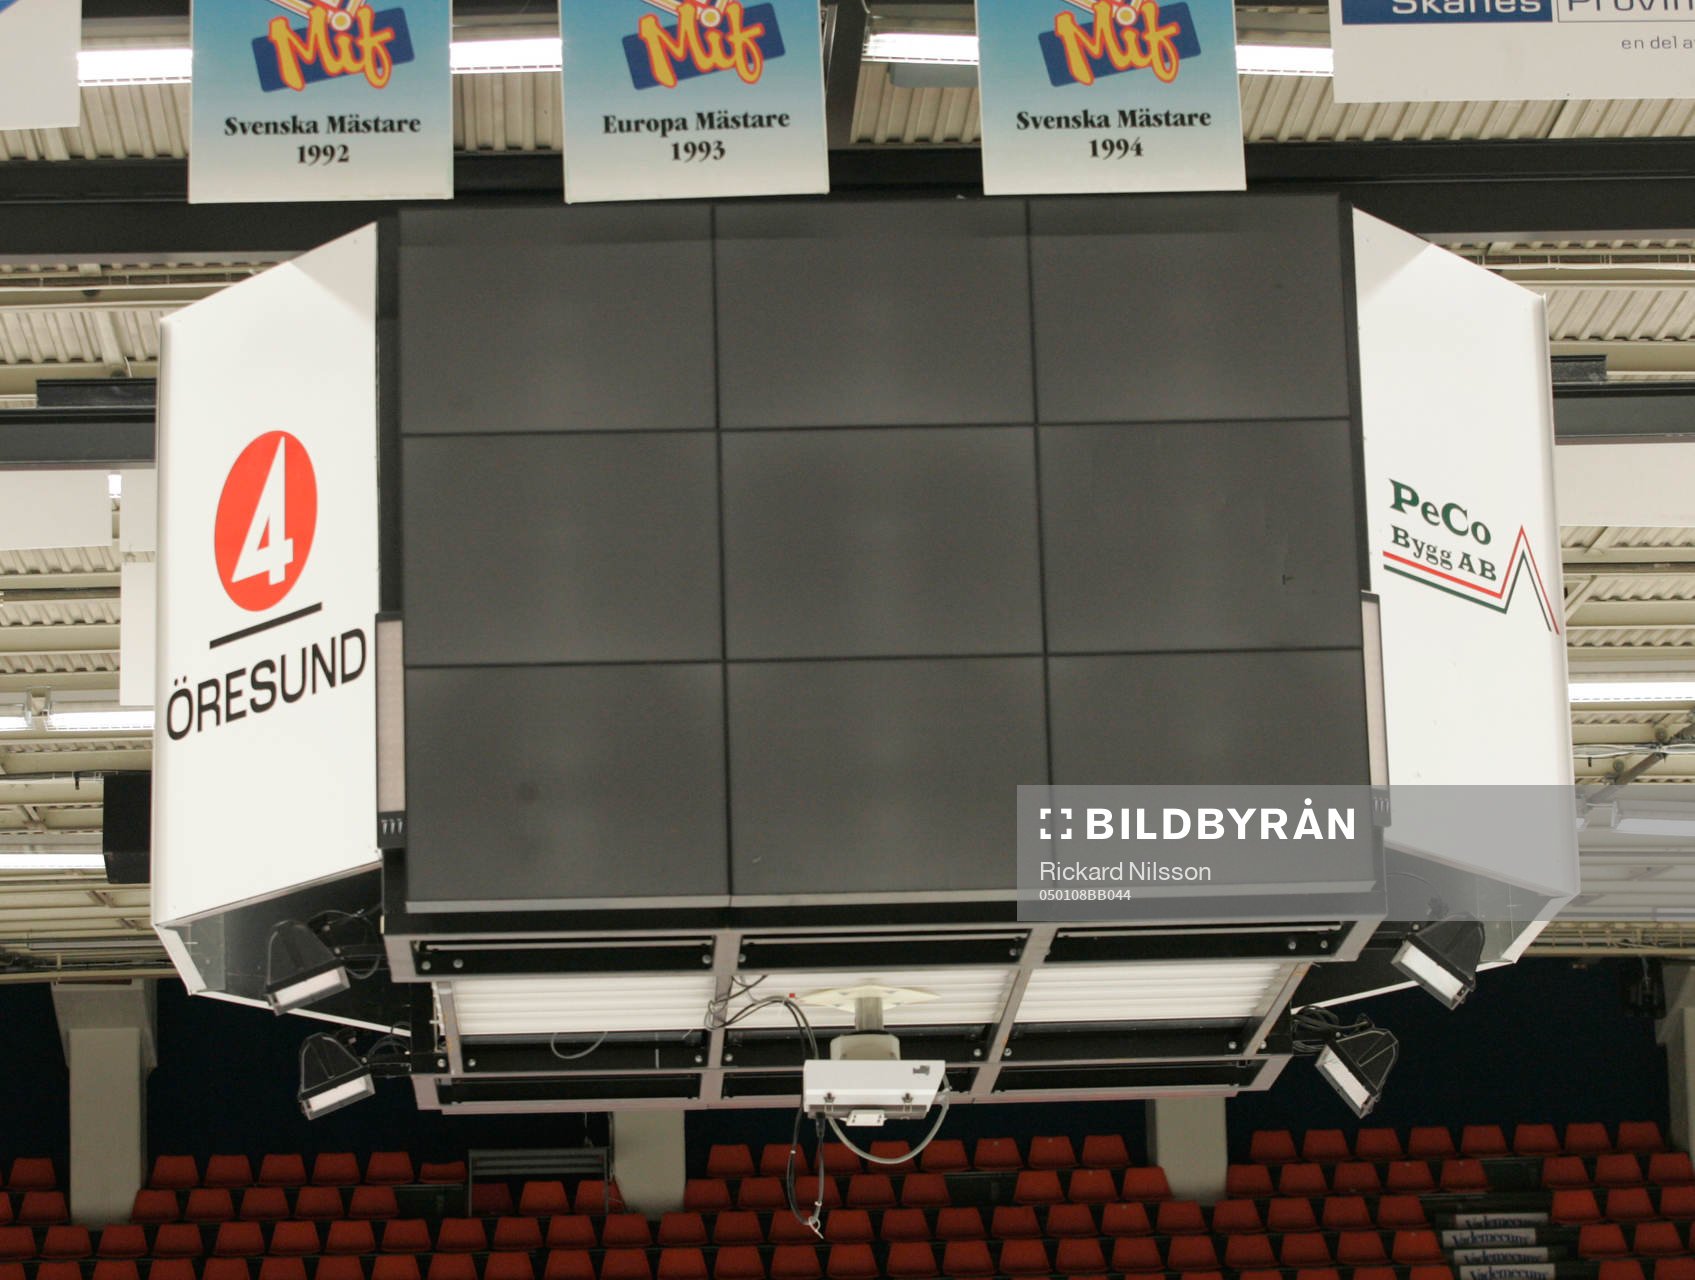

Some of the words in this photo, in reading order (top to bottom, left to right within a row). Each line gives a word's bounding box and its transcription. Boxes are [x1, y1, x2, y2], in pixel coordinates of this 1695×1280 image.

[1621, 39, 1644, 49] en
[1650, 35, 1677, 49] del
[1683, 39, 1695, 49] a
[224, 115, 318, 136] Svenska
[326, 113, 422, 135] Mästare
[602, 113, 688, 137] Europa
[695, 110, 790, 131] Mästare
[1016, 109, 1110, 130] Svenska
[1117, 108, 1212, 129] Mästare
[297, 144, 349, 166] 1992
[671, 140, 726, 163] 1993
[1089, 137, 1144, 160] 1994
[231, 435, 294, 586] 4
[1389, 478, 1491, 545] PeCo
[1391, 524, 1453, 571] Bygg
[1458, 552, 1497, 582] AB
[166, 628, 367, 741] ÖRESUND
